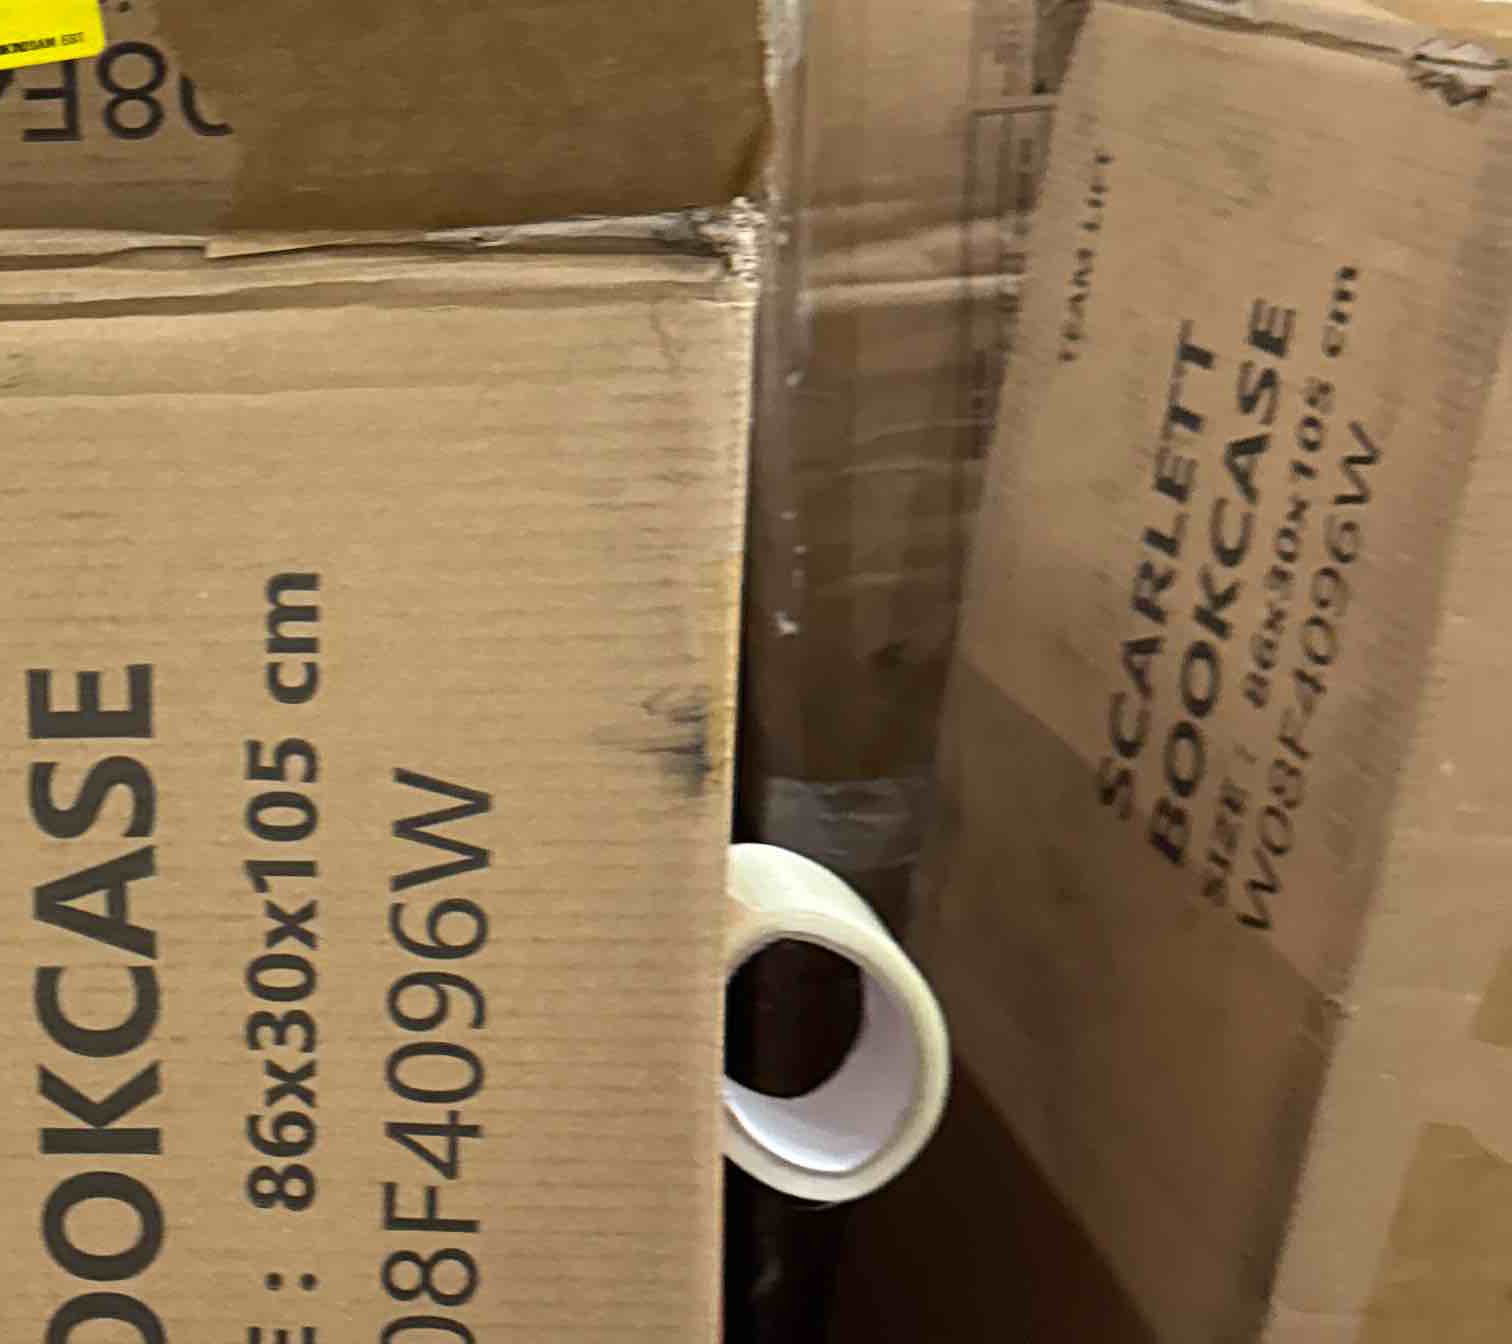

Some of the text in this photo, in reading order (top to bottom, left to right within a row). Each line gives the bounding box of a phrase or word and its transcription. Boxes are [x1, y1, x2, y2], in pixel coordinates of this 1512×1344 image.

[262, 569, 323, 706] cm
[1095, 319, 1216, 821] SCARLETT
[1146, 298, 1296, 866] BOOKCASE
[1235, 419, 1383, 933] W08F4096W
[244, 734, 322, 1215] 86x30x105
